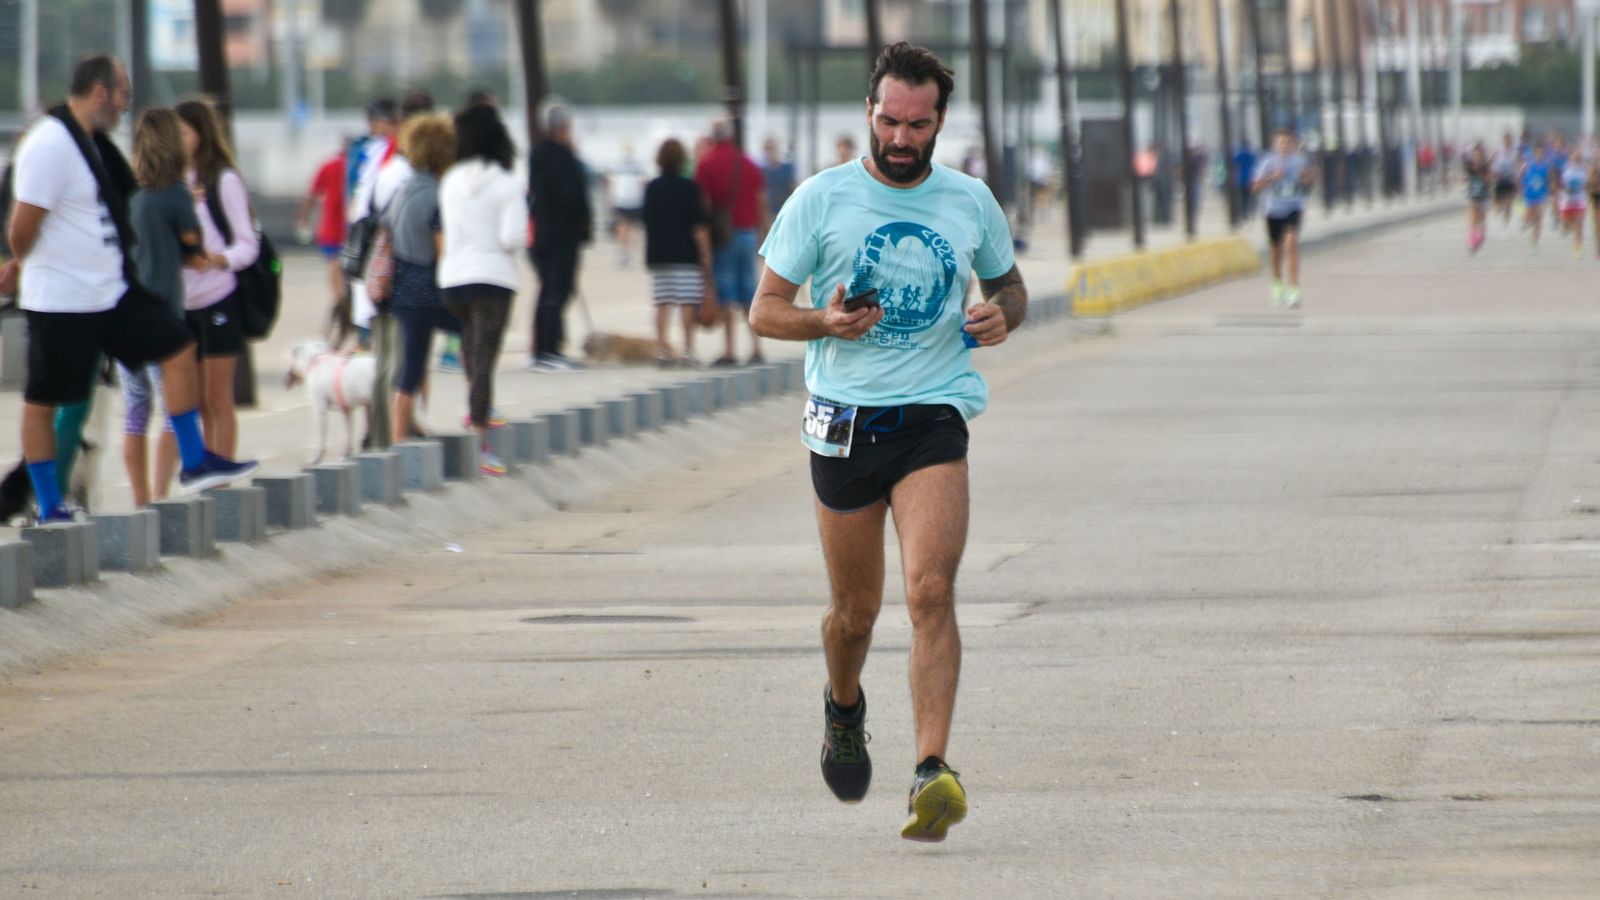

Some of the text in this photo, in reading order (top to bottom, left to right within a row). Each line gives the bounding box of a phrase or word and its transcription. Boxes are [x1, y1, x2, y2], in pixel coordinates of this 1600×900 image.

[921, 229, 957, 270] 2022
[865, 329, 910, 345] irgen
[803, 399, 835, 439] 65
